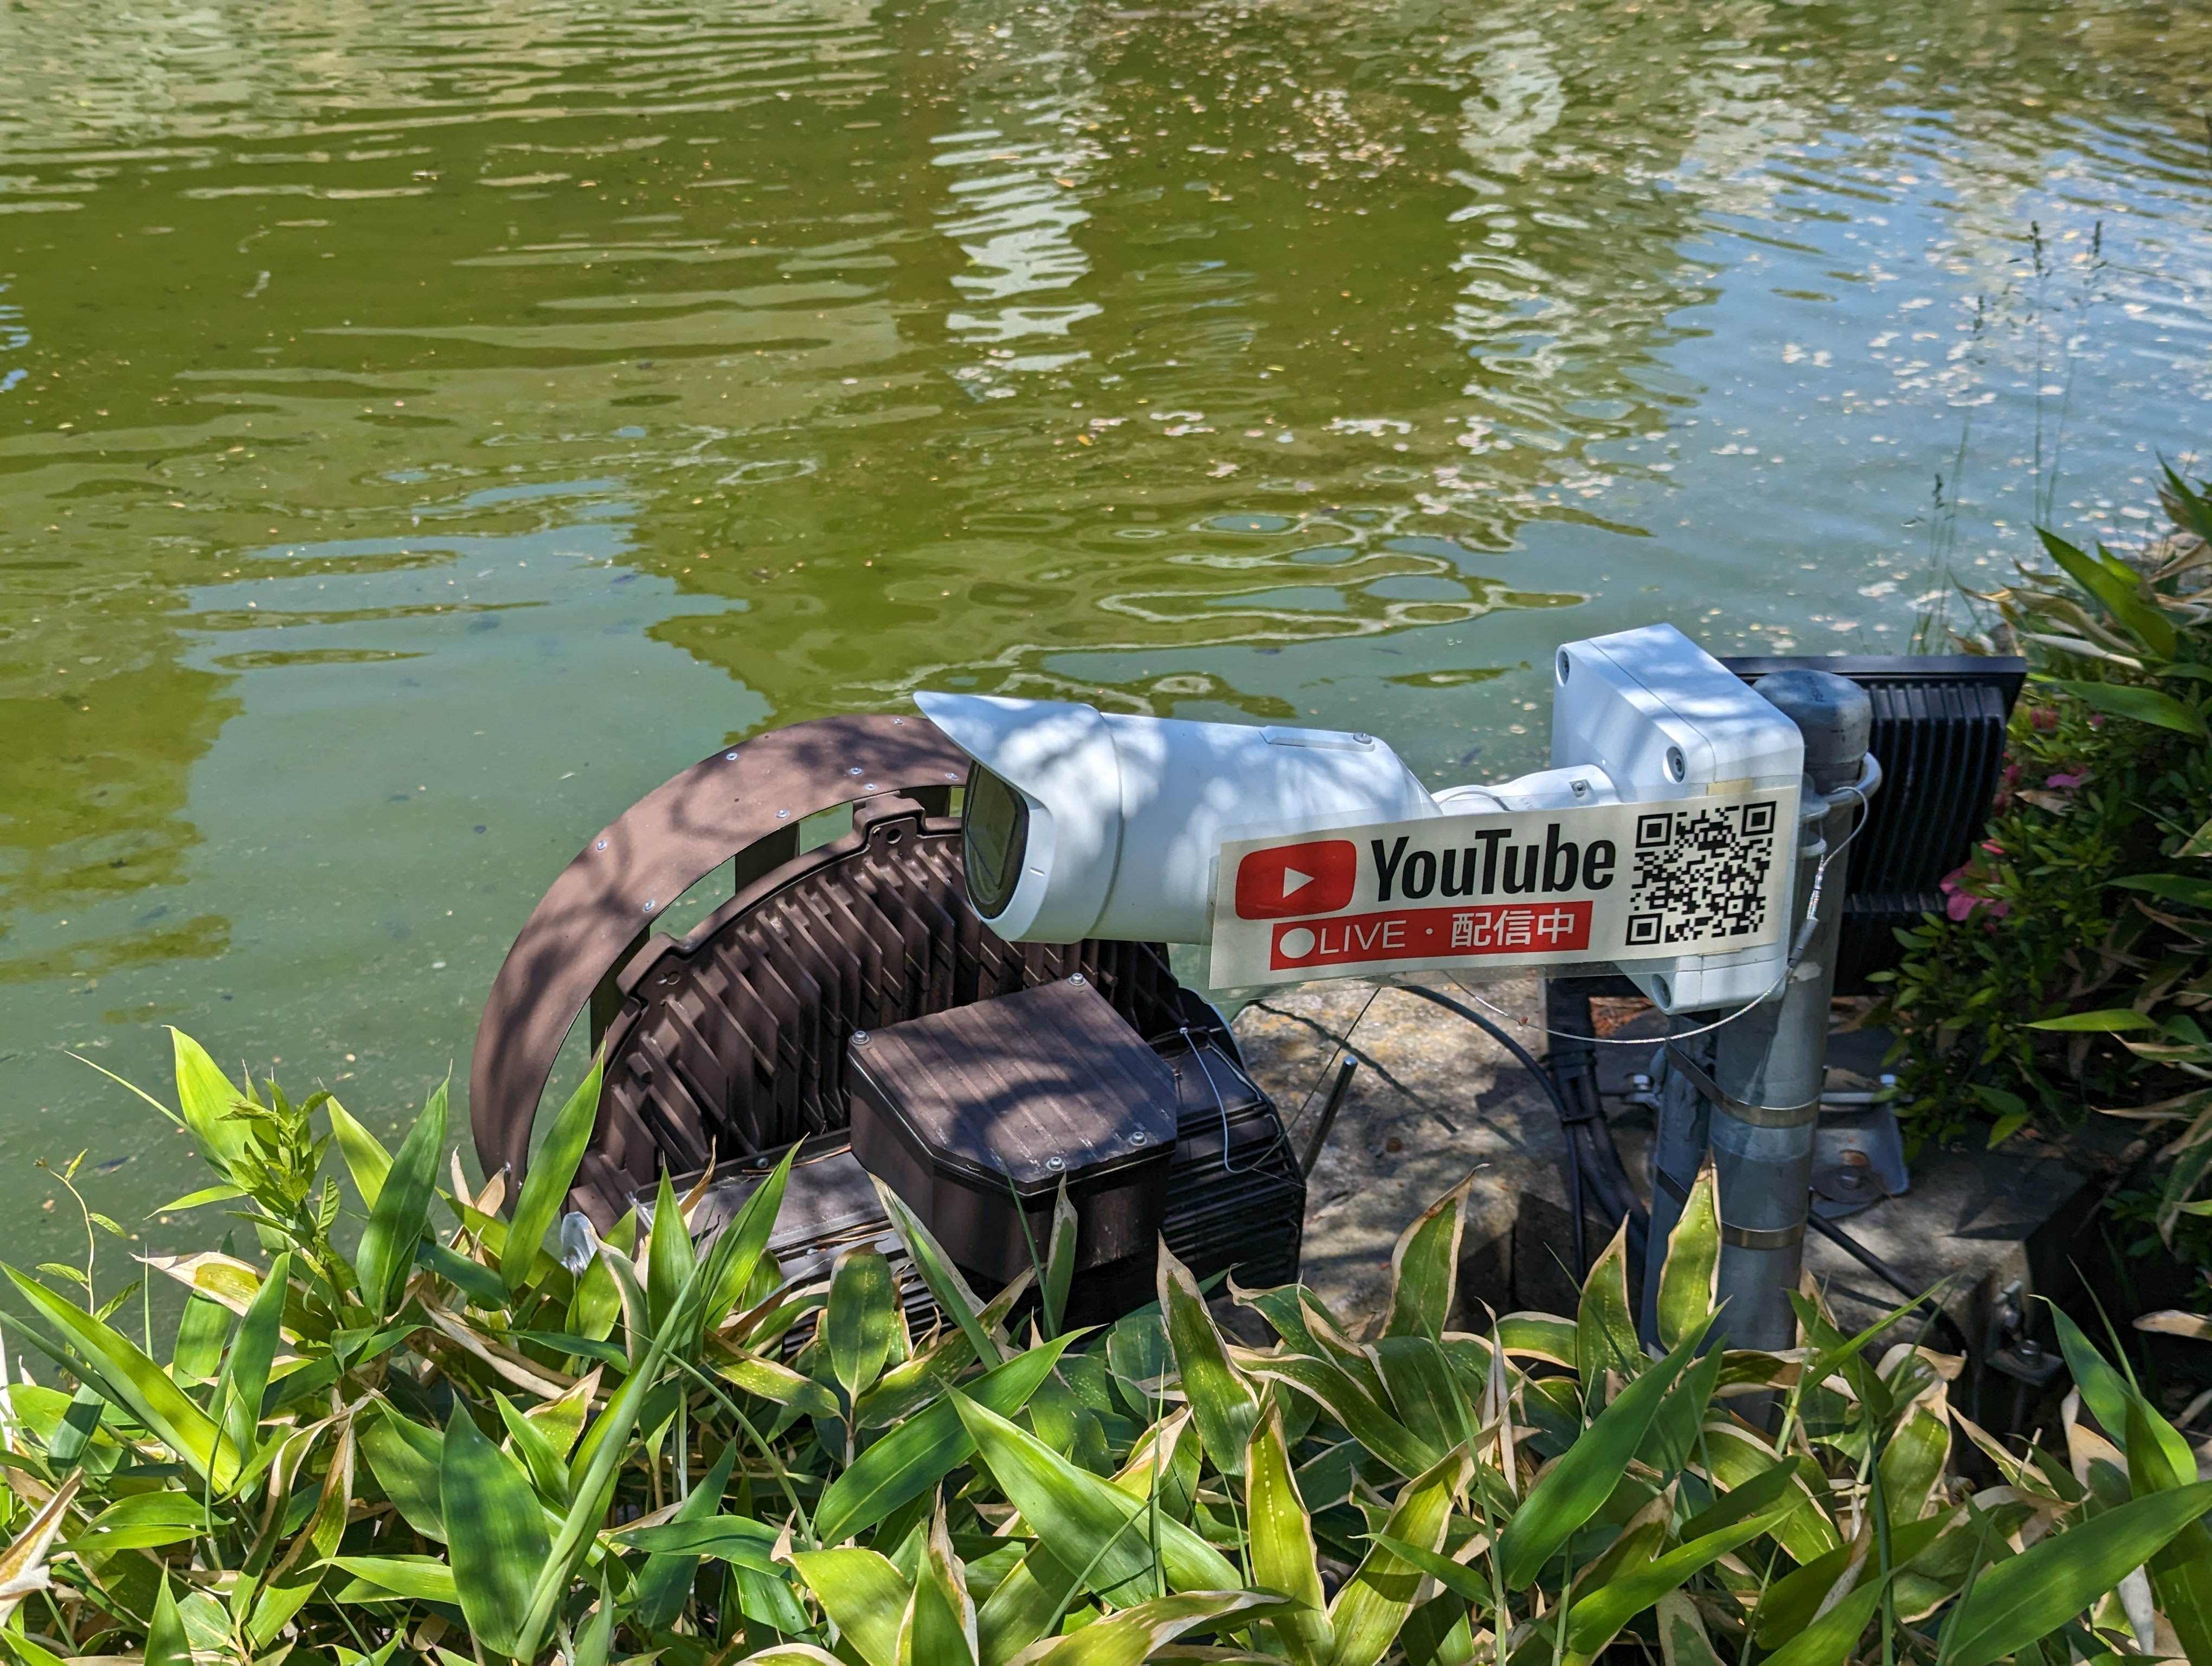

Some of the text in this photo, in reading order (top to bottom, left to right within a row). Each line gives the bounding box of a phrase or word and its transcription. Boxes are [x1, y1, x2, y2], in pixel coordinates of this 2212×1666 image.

[1370, 823, 1617, 903] YouTube
[1450, 907, 1575, 949] 配信中
